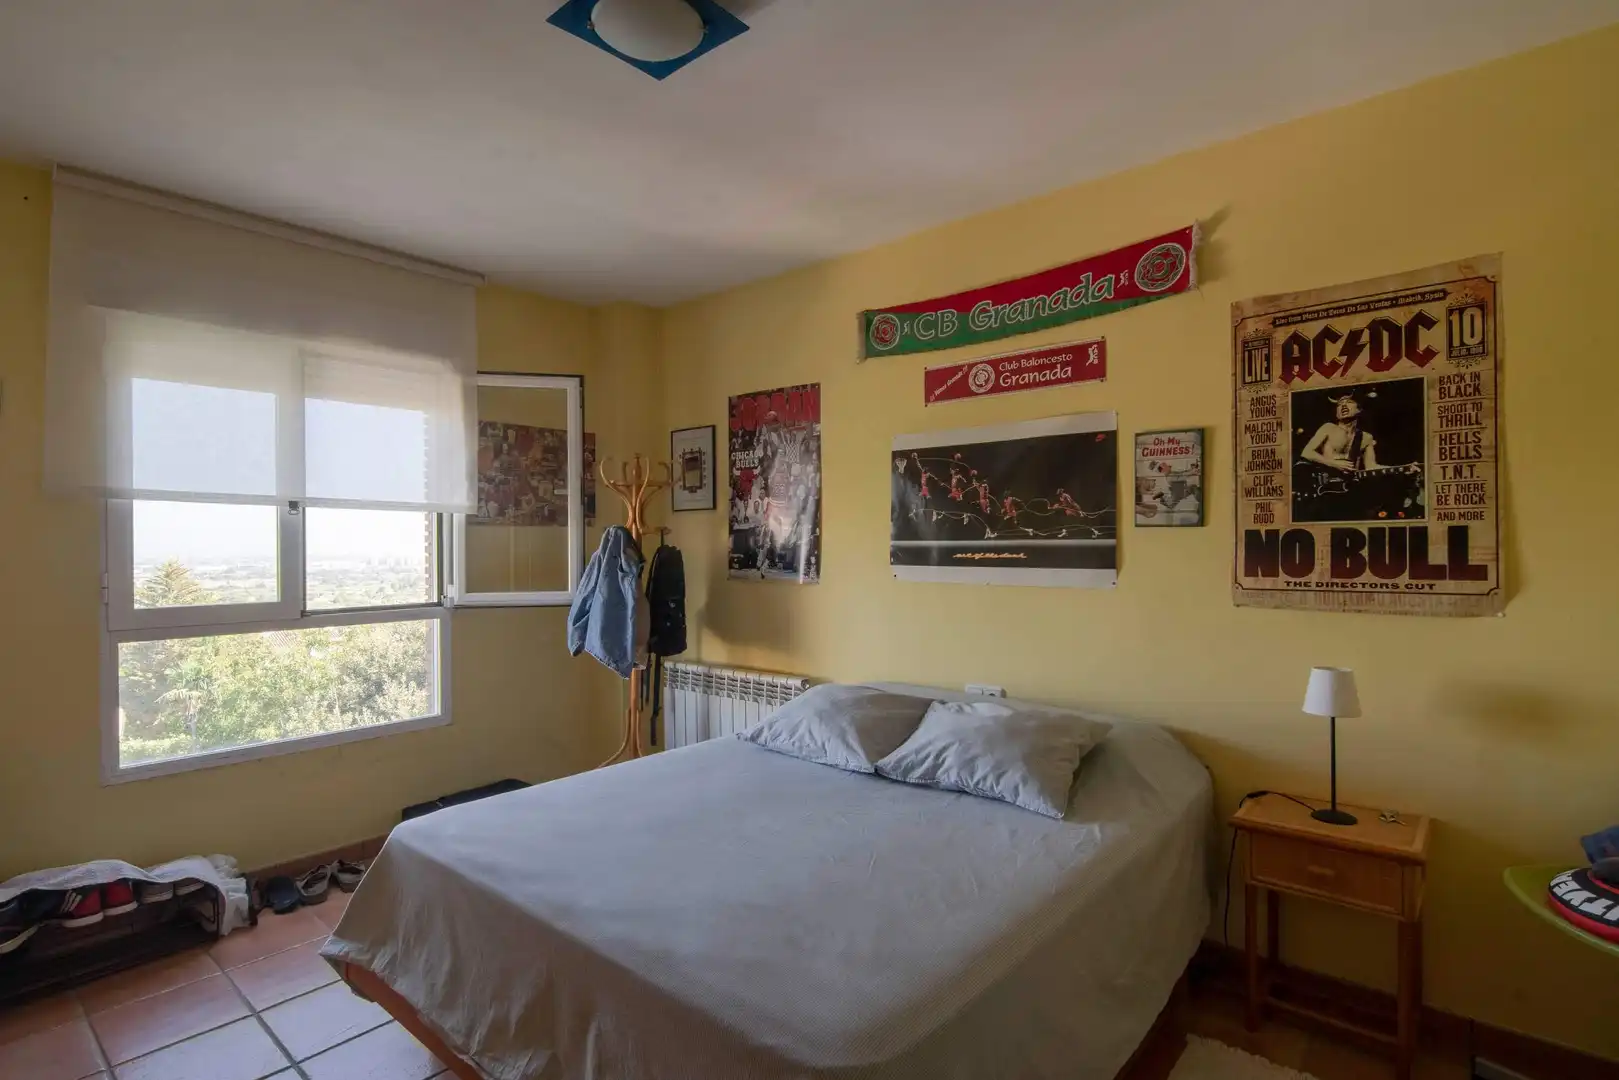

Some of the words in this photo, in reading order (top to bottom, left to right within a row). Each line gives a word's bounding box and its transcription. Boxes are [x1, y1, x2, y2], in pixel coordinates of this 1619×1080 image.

[914, 309, 958, 340] CB
[969, 273, 1115, 331] Granada
[1450, 307, 1483, 347] 10
[999, 360, 1018, 372] Club
[1021, 353, 1073, 369] Baloncesto
[1245, 347, 1270, 383] LIVE
[999, 363, 1072, 387] Granada
[1439, 374, 1466, 386] BACK
[1469, 372, 1481, 383] IN
[1438, 384, 1483, 400] BLACK
[1250, 395, 1276, 408] ANGUS
[1437, 403, 1467, 415] SHOOT
[1472, 401, 1483, 412] TO
[1250, 406, 1276, 418] YOUNG
[1438, 412, 1482, 428] THRILL
[1245, 421, 1283, 435] MALCOLM
[1154, 437, 1165, 446] Oh
[1250, 433, 1277, 445] YOUNG
[1439, 431, 1482, 446] HELLS
[1142, 444, 1194, 457] GUINNESS!
[1251, 448, 1276, 461] BRIAN
[1438, 444, 1482, 461] BELLS
[736, 459, 760, 469] BULLS
[1245, 459, 1283, 472] JOHNSON
[1440, 464, 1480, 480] T.N.T.
[1252, 475, 1275, 487] CLIFF
[1245, 486, 1283, 498] WILLIAMS
[1436, 484, 1453, 494] LET
[1455, 482, 1486, 494] THERE
[1437, 494, 1451, 506] BE
[1454, 493, 1486, 505] ROCK
[1255, 502, 1273, 513] PHIL
[1253, 513, 1275, 524] RUDD
[1437, 511, 1456, 522] AND
[1459, 511, 1485, 521] MORE
[1244, 528, 1316, 579] NO
[1330, 525, 1488, 581] BULL
[1284, 581, 1311, 590] THE
[1315, 581, 1400, 592] DIRECTORS
[1404, 583, 1436, 593] CUT
